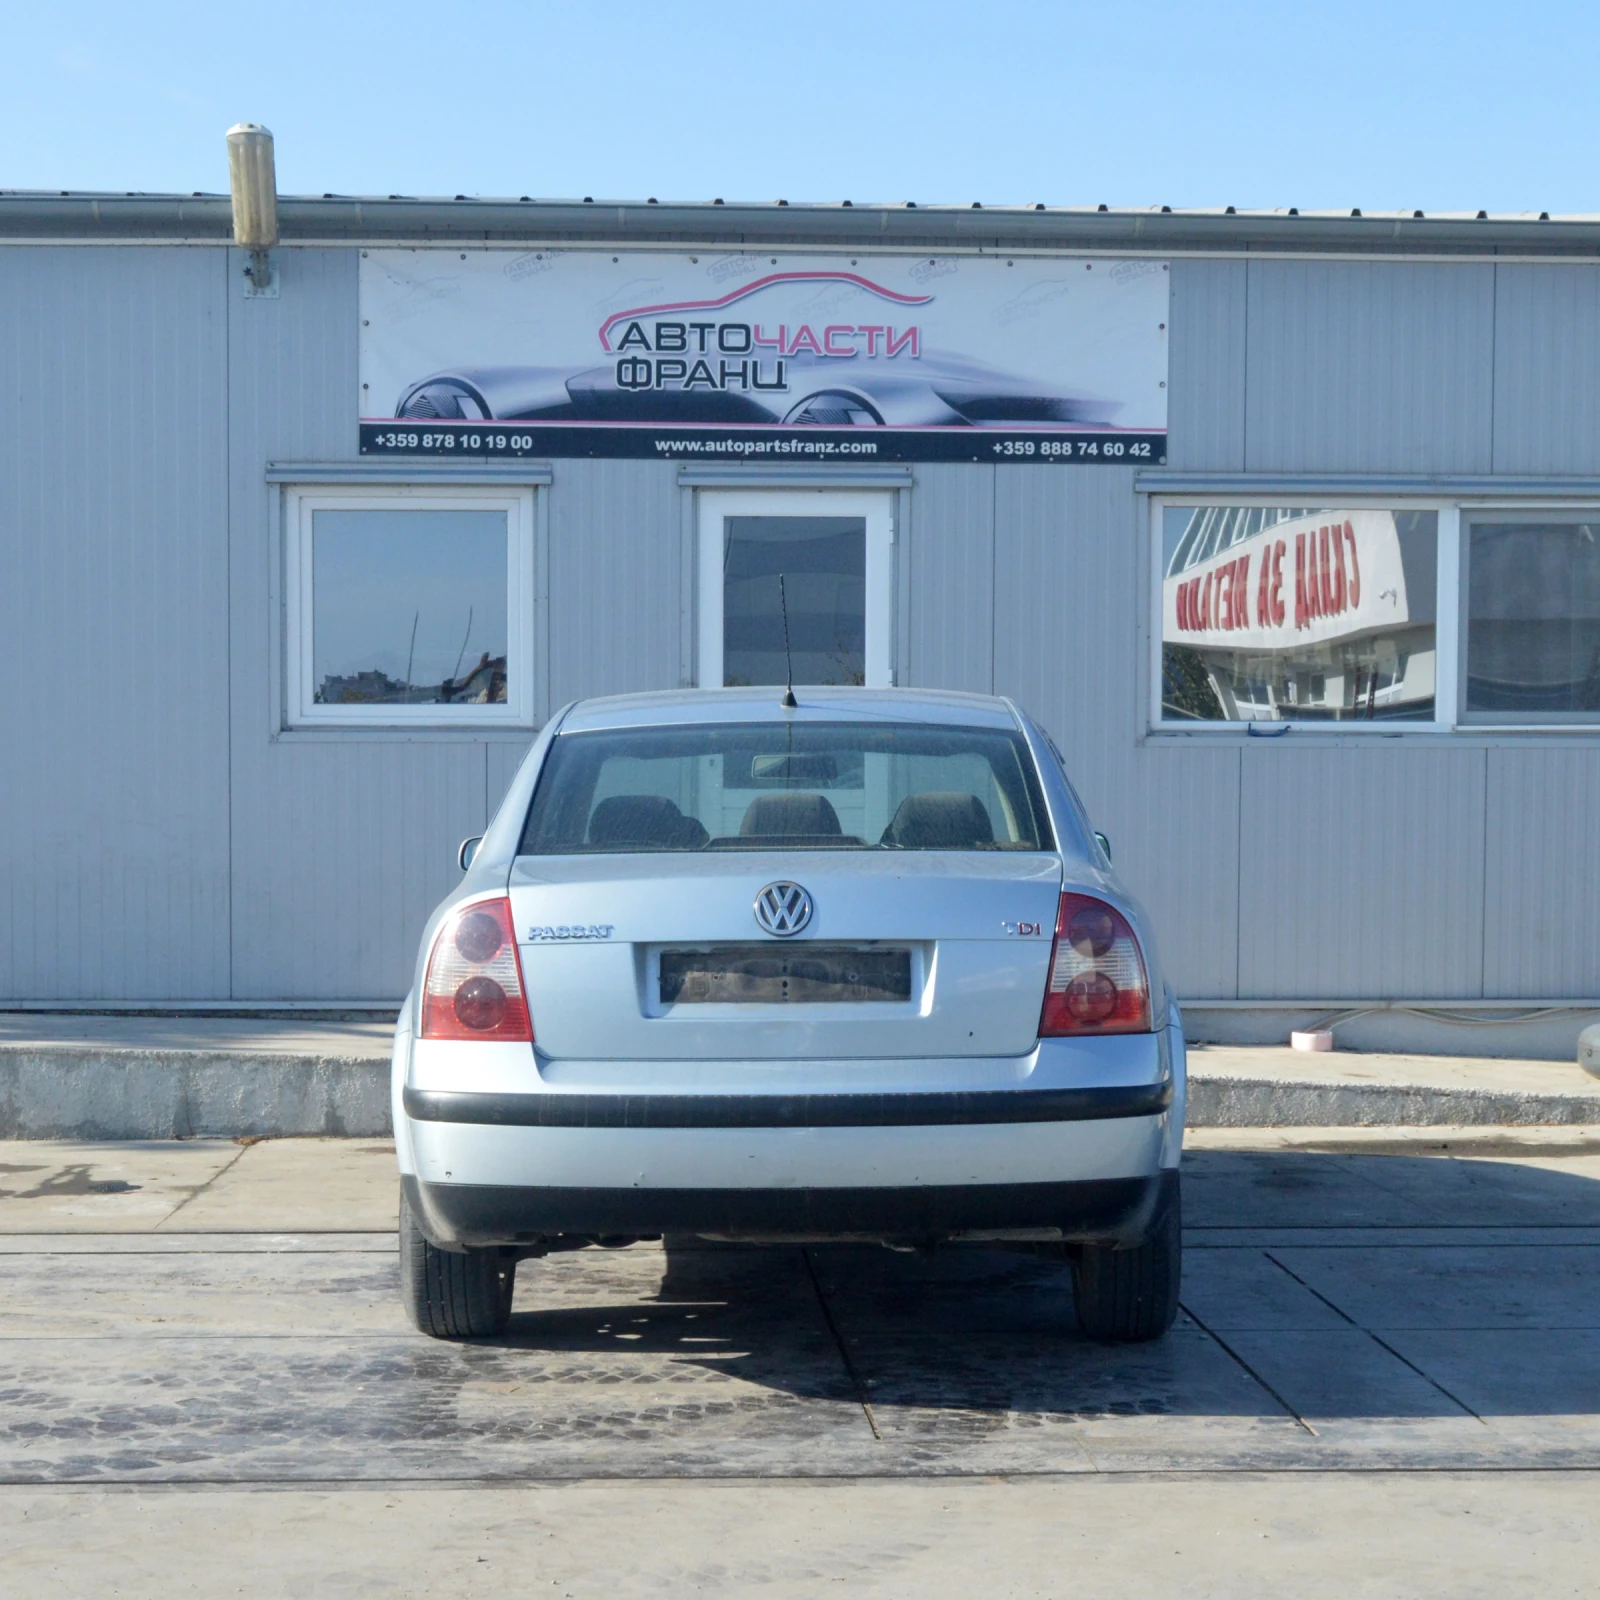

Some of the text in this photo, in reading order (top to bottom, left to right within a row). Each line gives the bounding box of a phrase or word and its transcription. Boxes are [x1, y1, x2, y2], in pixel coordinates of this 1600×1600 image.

[617, 322, 919, 356] АВТОЧАСТИ
[616, 355, 787, 390] ФРАНЦ
[375, 433, 533, 449] +359 878 10 19 00
[655, 439, 877, 455] www.autopartsfranz.com
[993, 441, 1151, 457] +359 888 74 60 42
[528, 924, 615, 941] PASSAT
[1001, 921, 1042, 936] TDI
